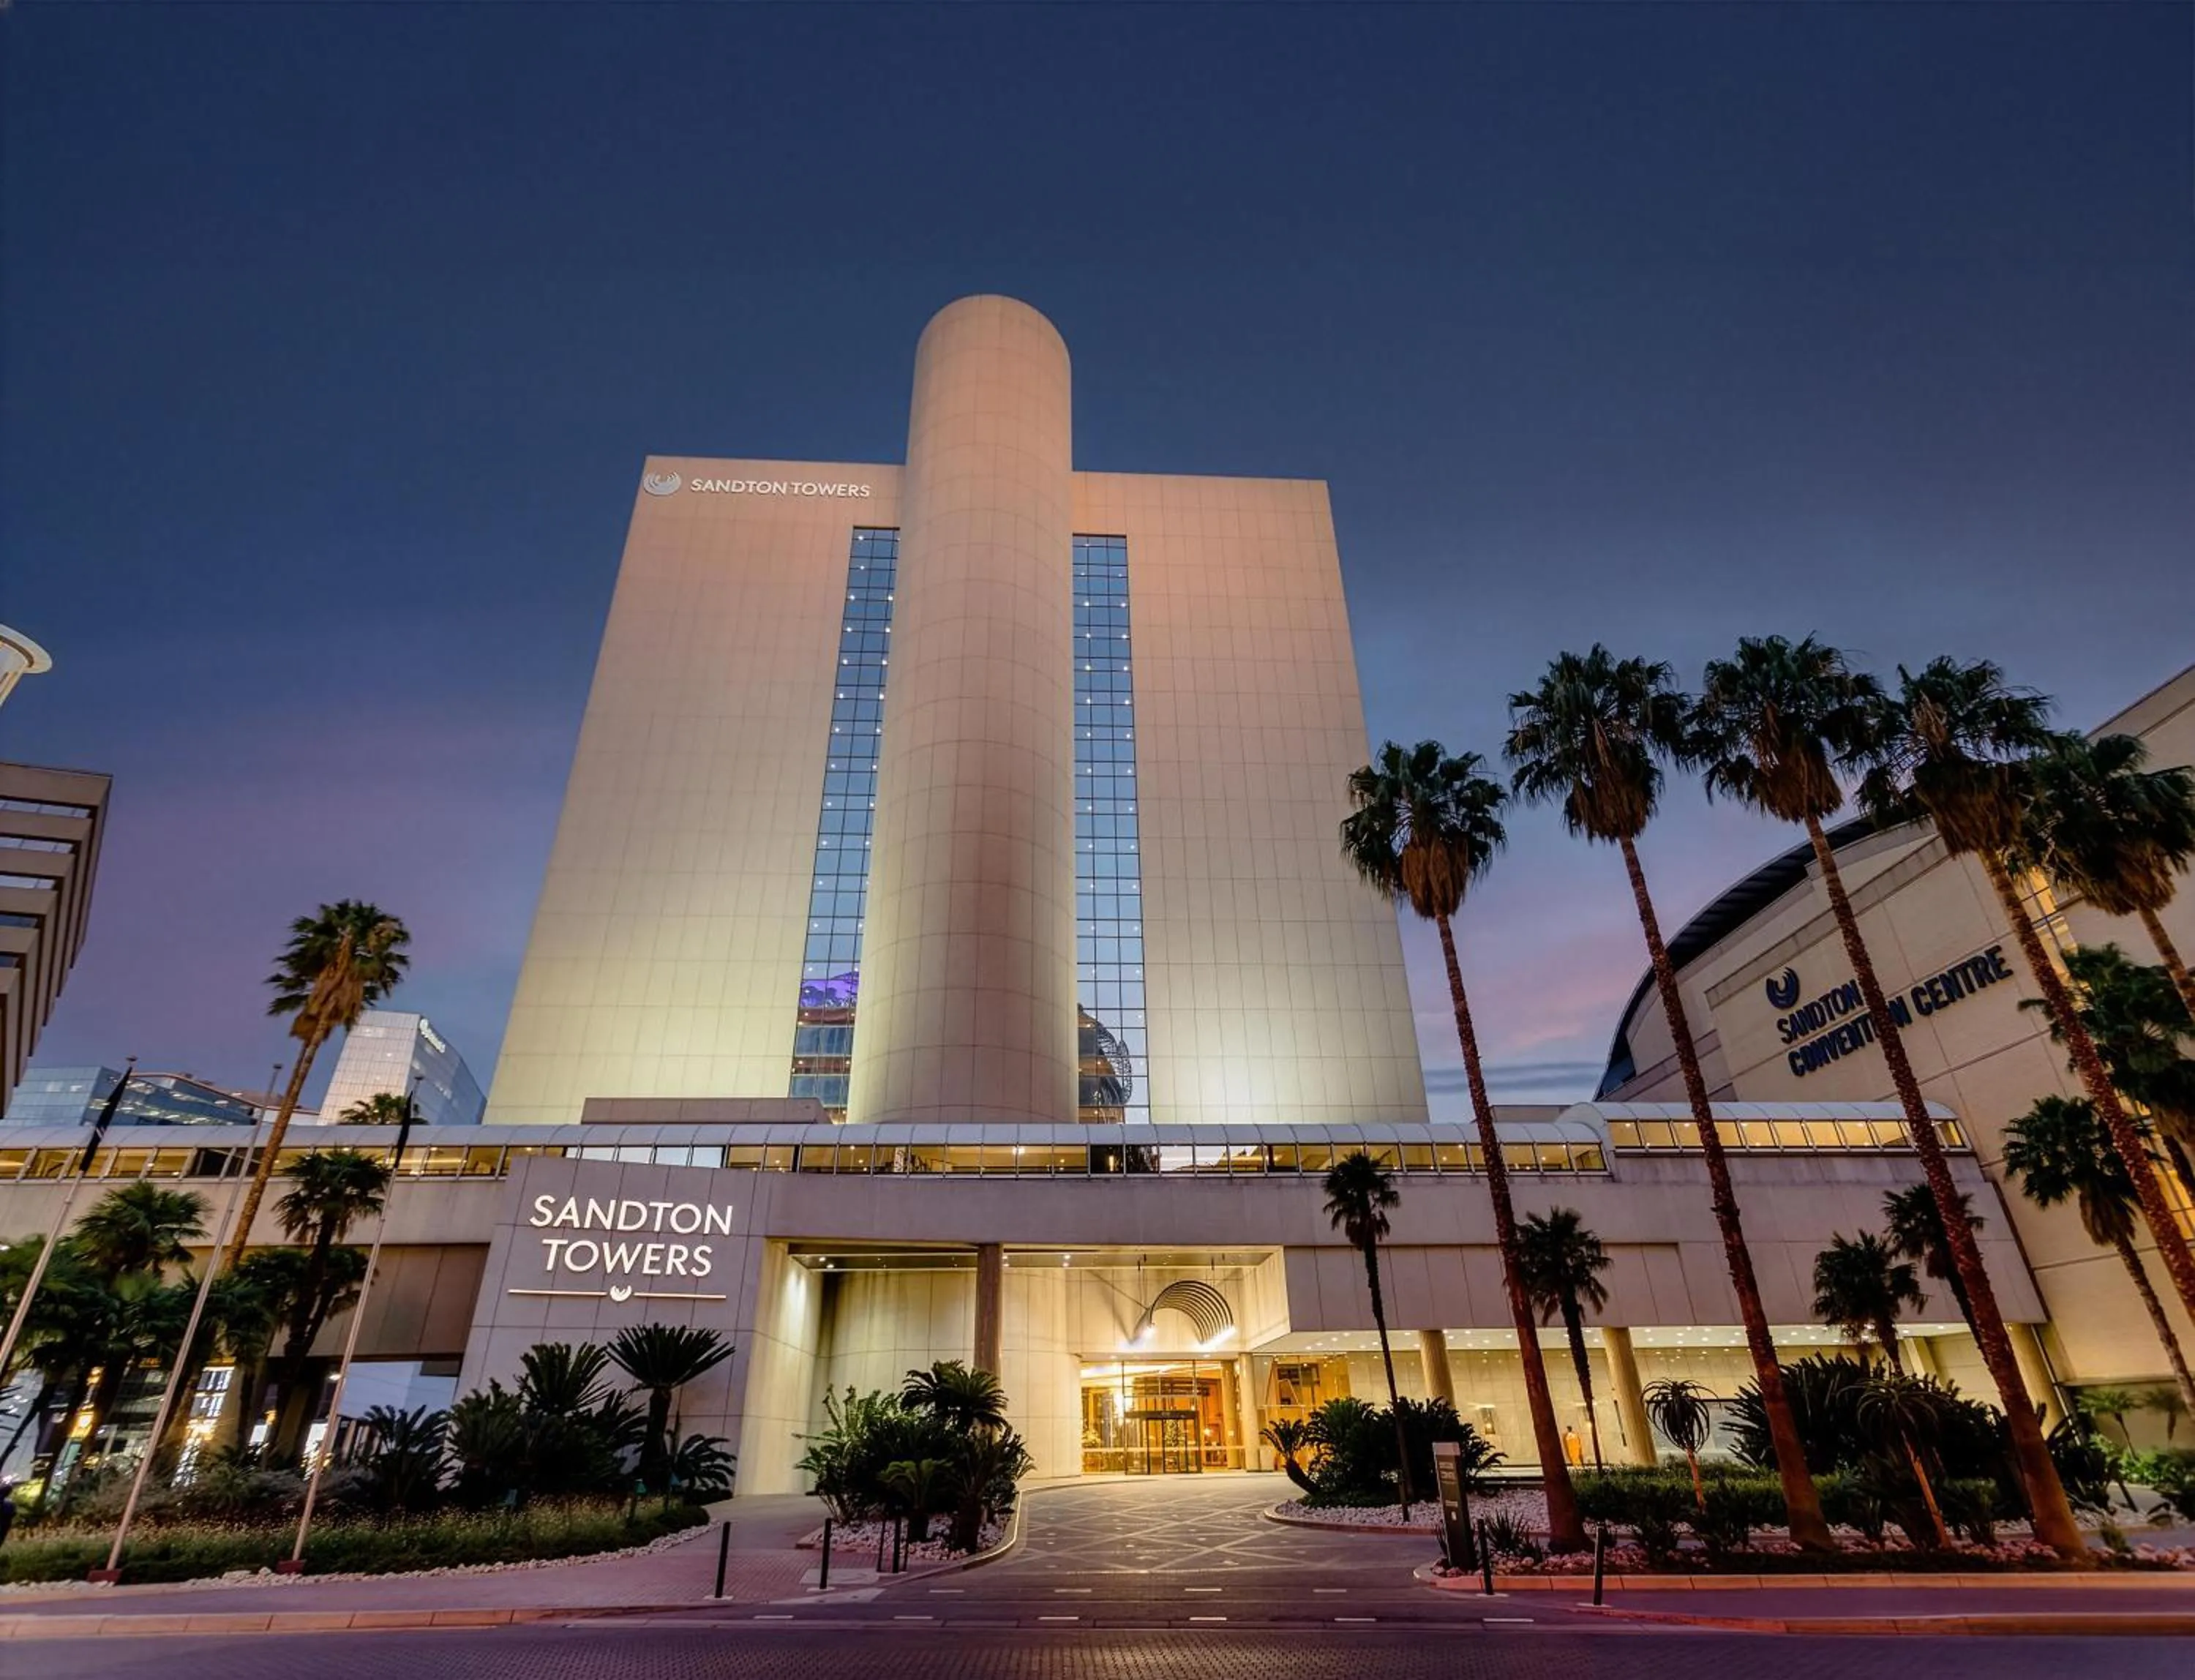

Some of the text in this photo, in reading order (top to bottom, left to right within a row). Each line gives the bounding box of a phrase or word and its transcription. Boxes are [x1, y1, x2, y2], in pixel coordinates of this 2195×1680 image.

[691, 479, 871, 498] SANDTON TOWERS
[1776, 979, 1864, 1044] SANDTON
[1787, 945, 2014, 1077] CONVENTIN CENTRE
[529, 1195, 732, 1236] SANDTON
[542, 1239, 713, 1277] TOWERS
